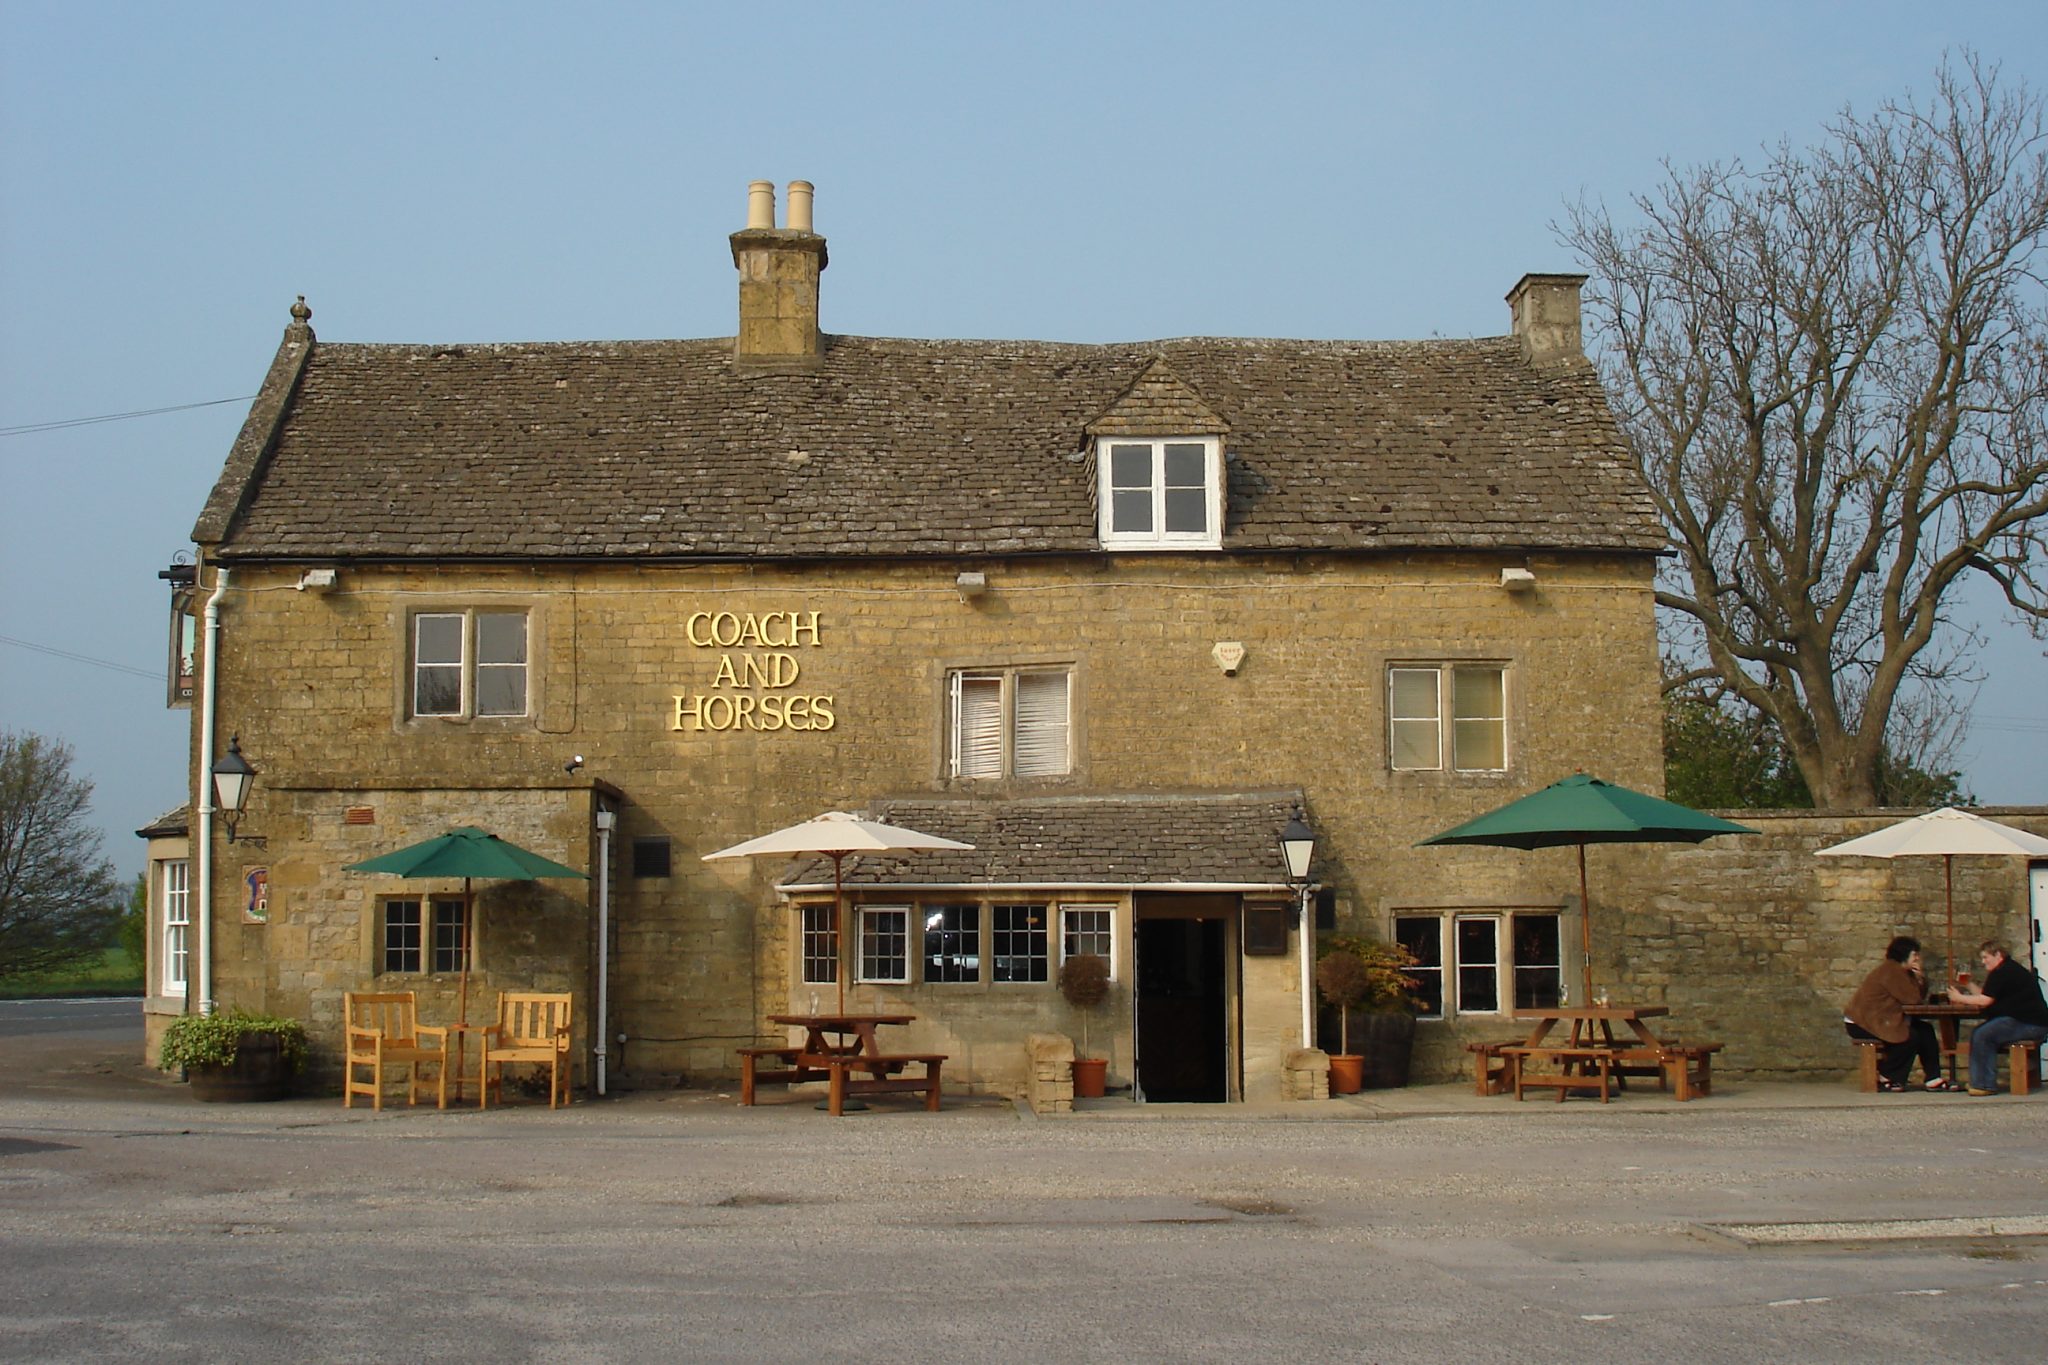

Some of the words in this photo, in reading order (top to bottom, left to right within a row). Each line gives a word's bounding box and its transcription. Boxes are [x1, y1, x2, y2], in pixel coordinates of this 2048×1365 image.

[686, 610, 821, 647] COACH
[711, 652, 800, 689] AND
[672, 694, 836, 731] HORSES
